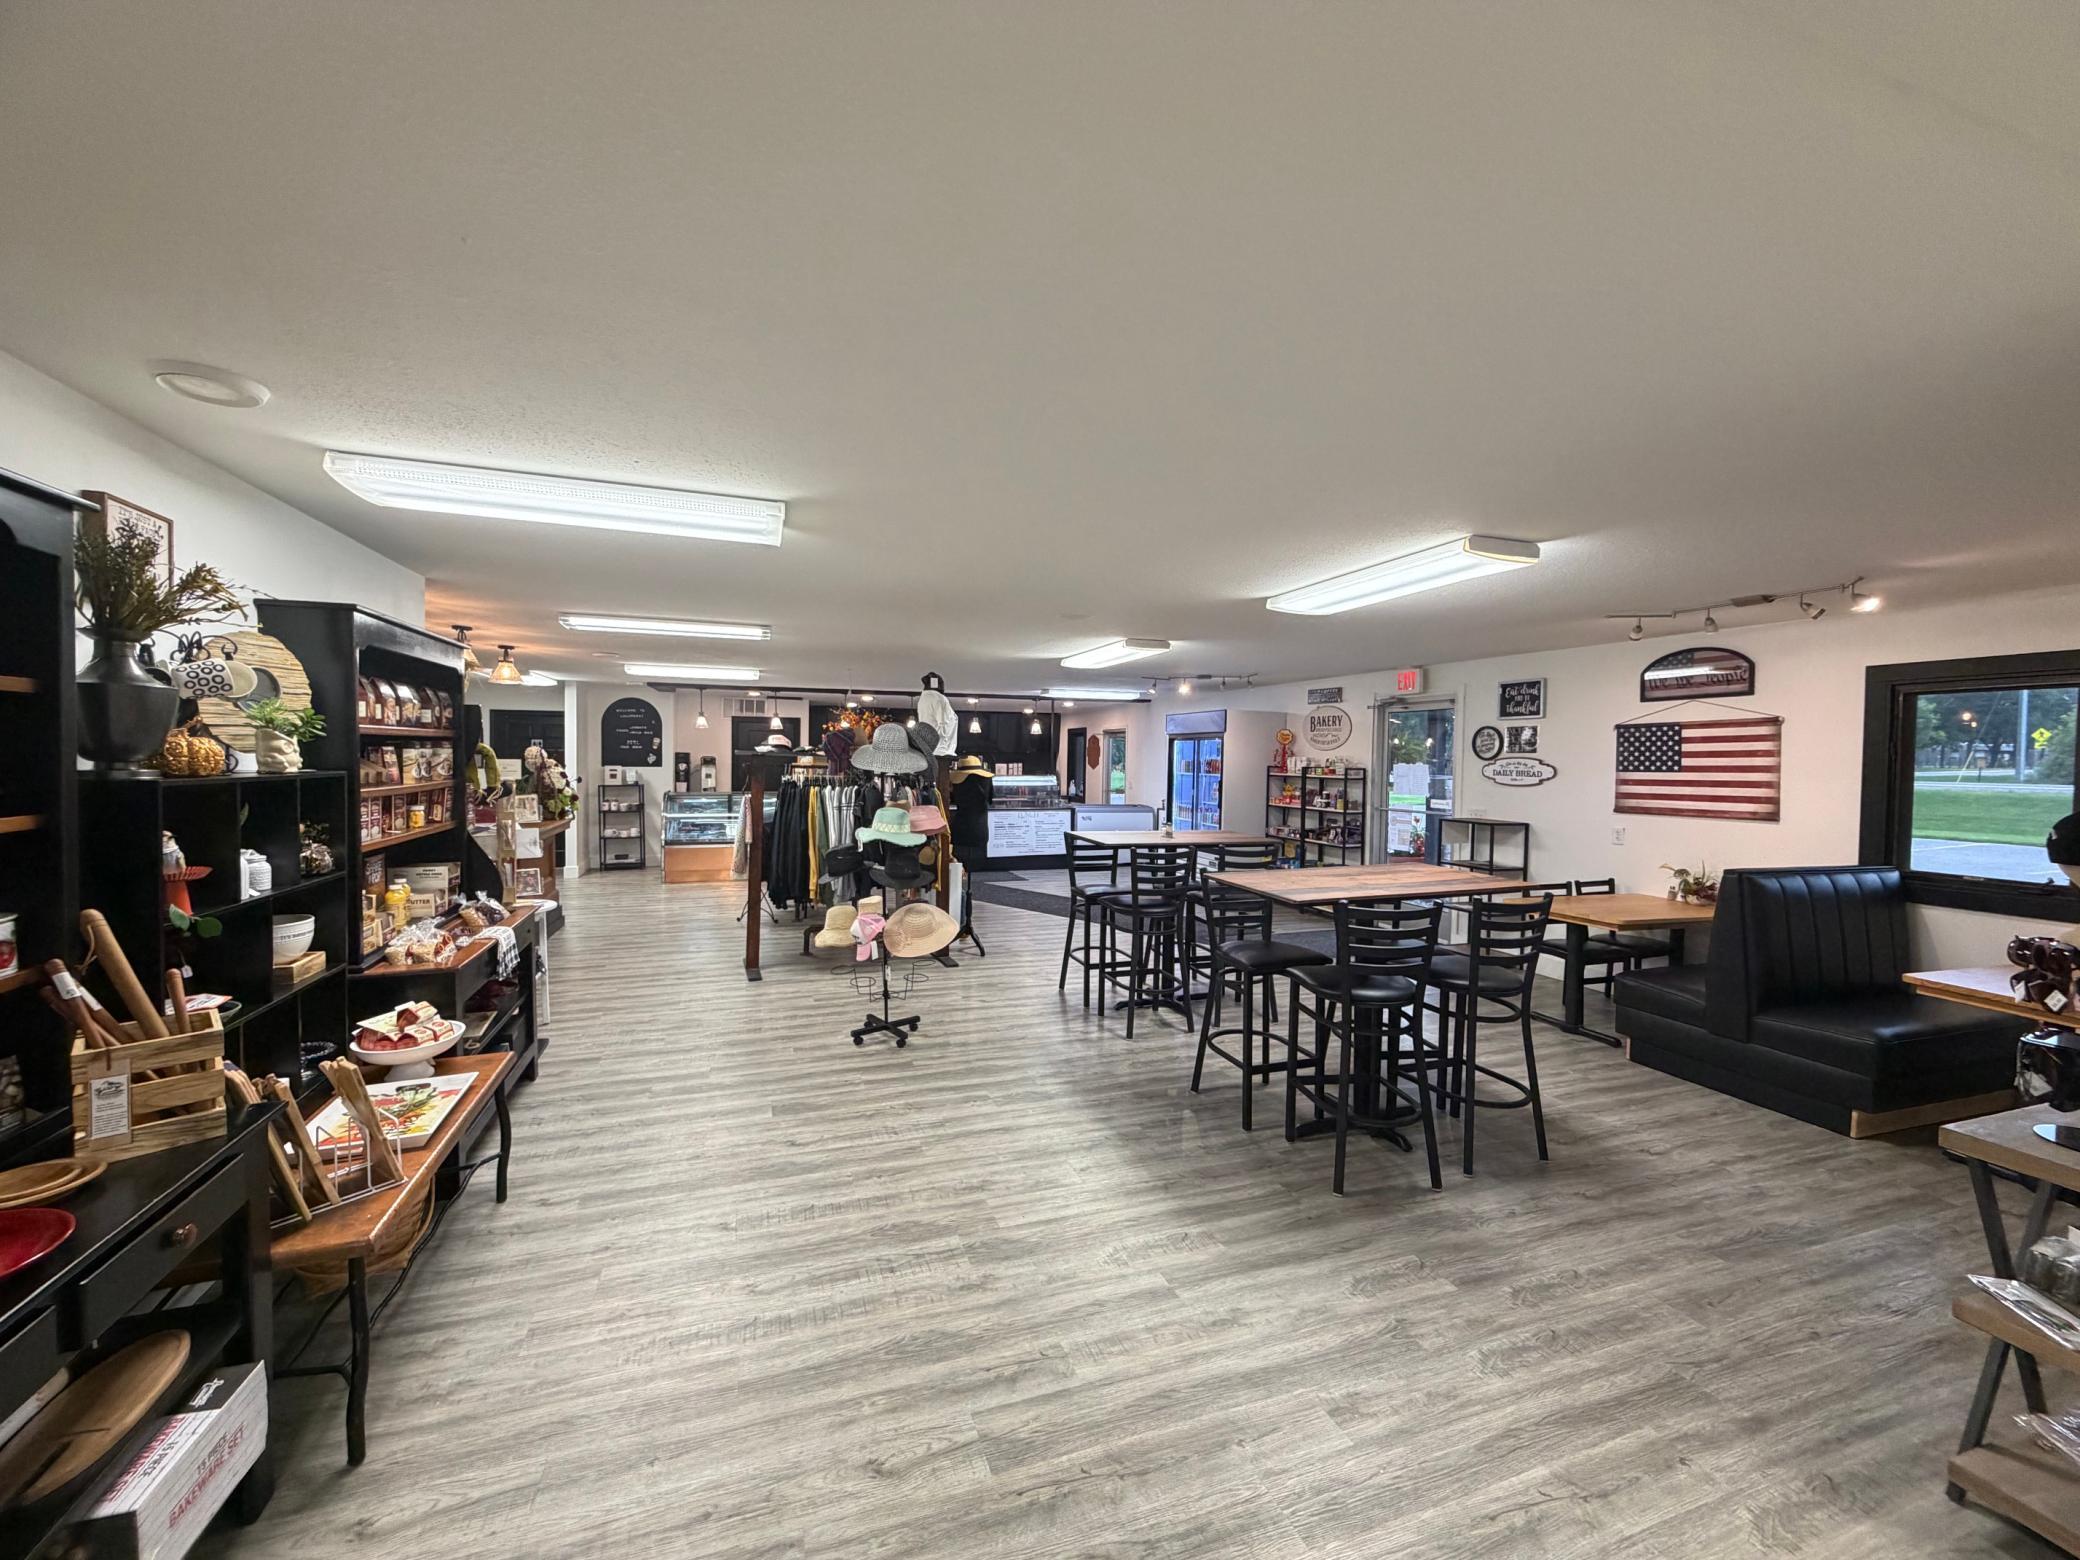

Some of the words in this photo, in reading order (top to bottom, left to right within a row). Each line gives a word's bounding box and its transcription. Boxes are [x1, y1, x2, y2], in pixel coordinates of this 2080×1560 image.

[1397, 671, 1417, 691] EXIT
[1309, 714, 1344, 733] BAKERY
[1492, 769, 1514, 777] DAILY
[1515, 769, 1543, 778] BREAD
[168, 1450, 225, 1530] BAKEWARE
[226, 1422, 246, 1456] SET
